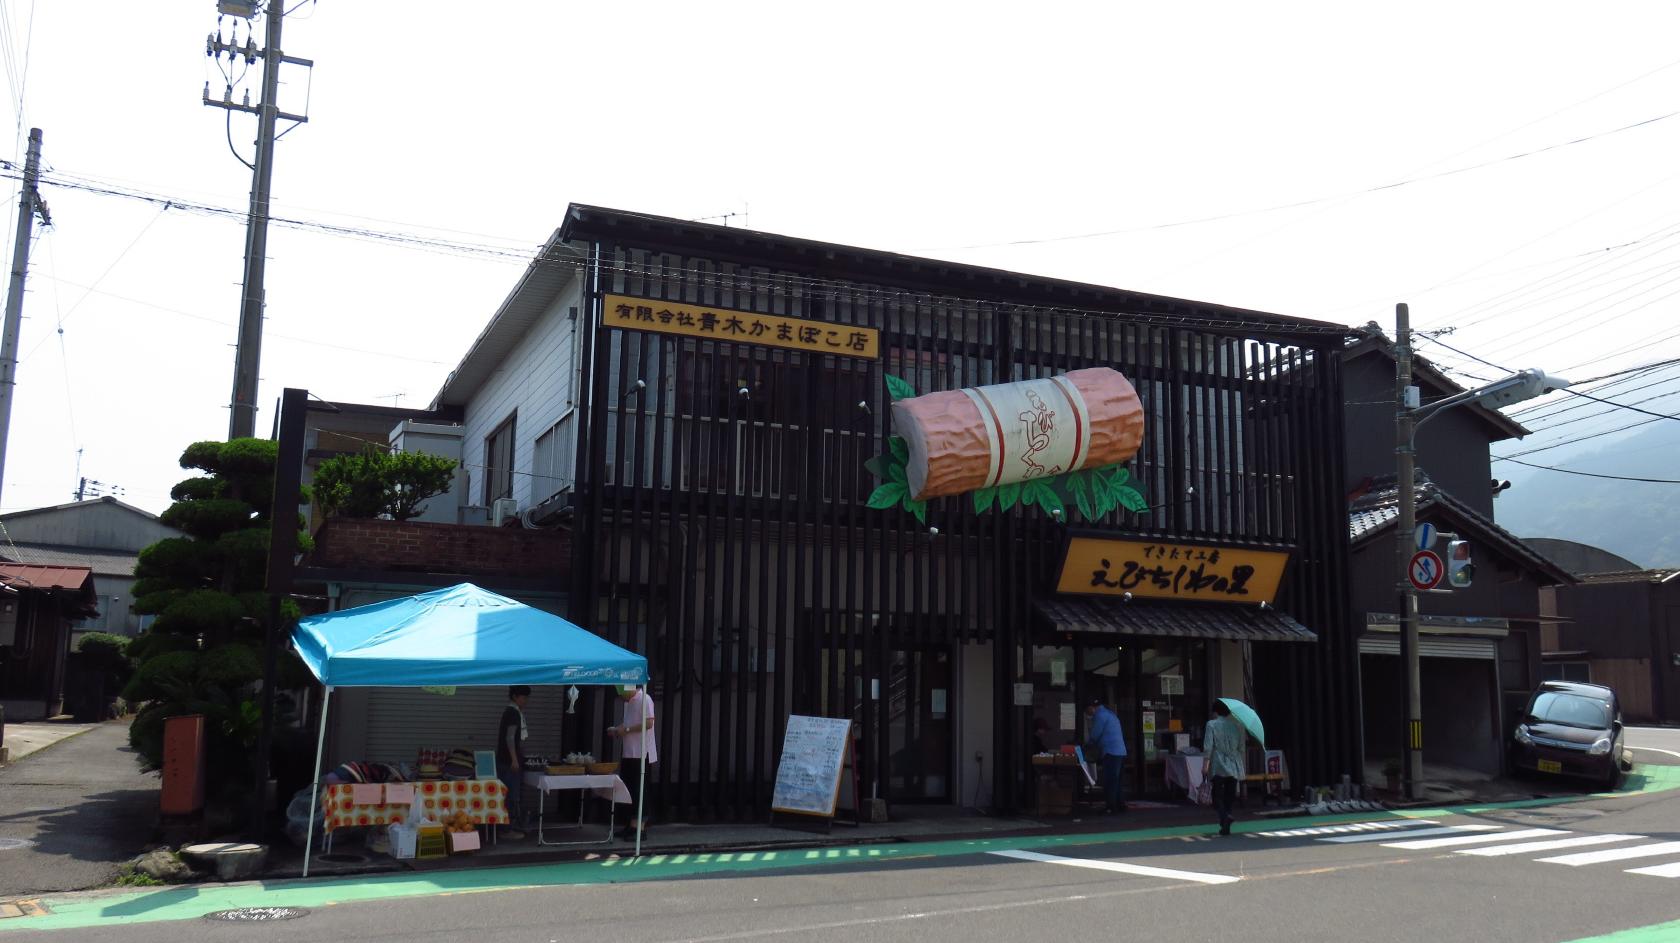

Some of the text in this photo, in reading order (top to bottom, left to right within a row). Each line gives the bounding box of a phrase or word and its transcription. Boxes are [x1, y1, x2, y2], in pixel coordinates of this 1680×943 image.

[614, 303, 869, 351] 有限会社青木かまぼこ店
[1091, 558, 1254, 595] えびちくわの里
